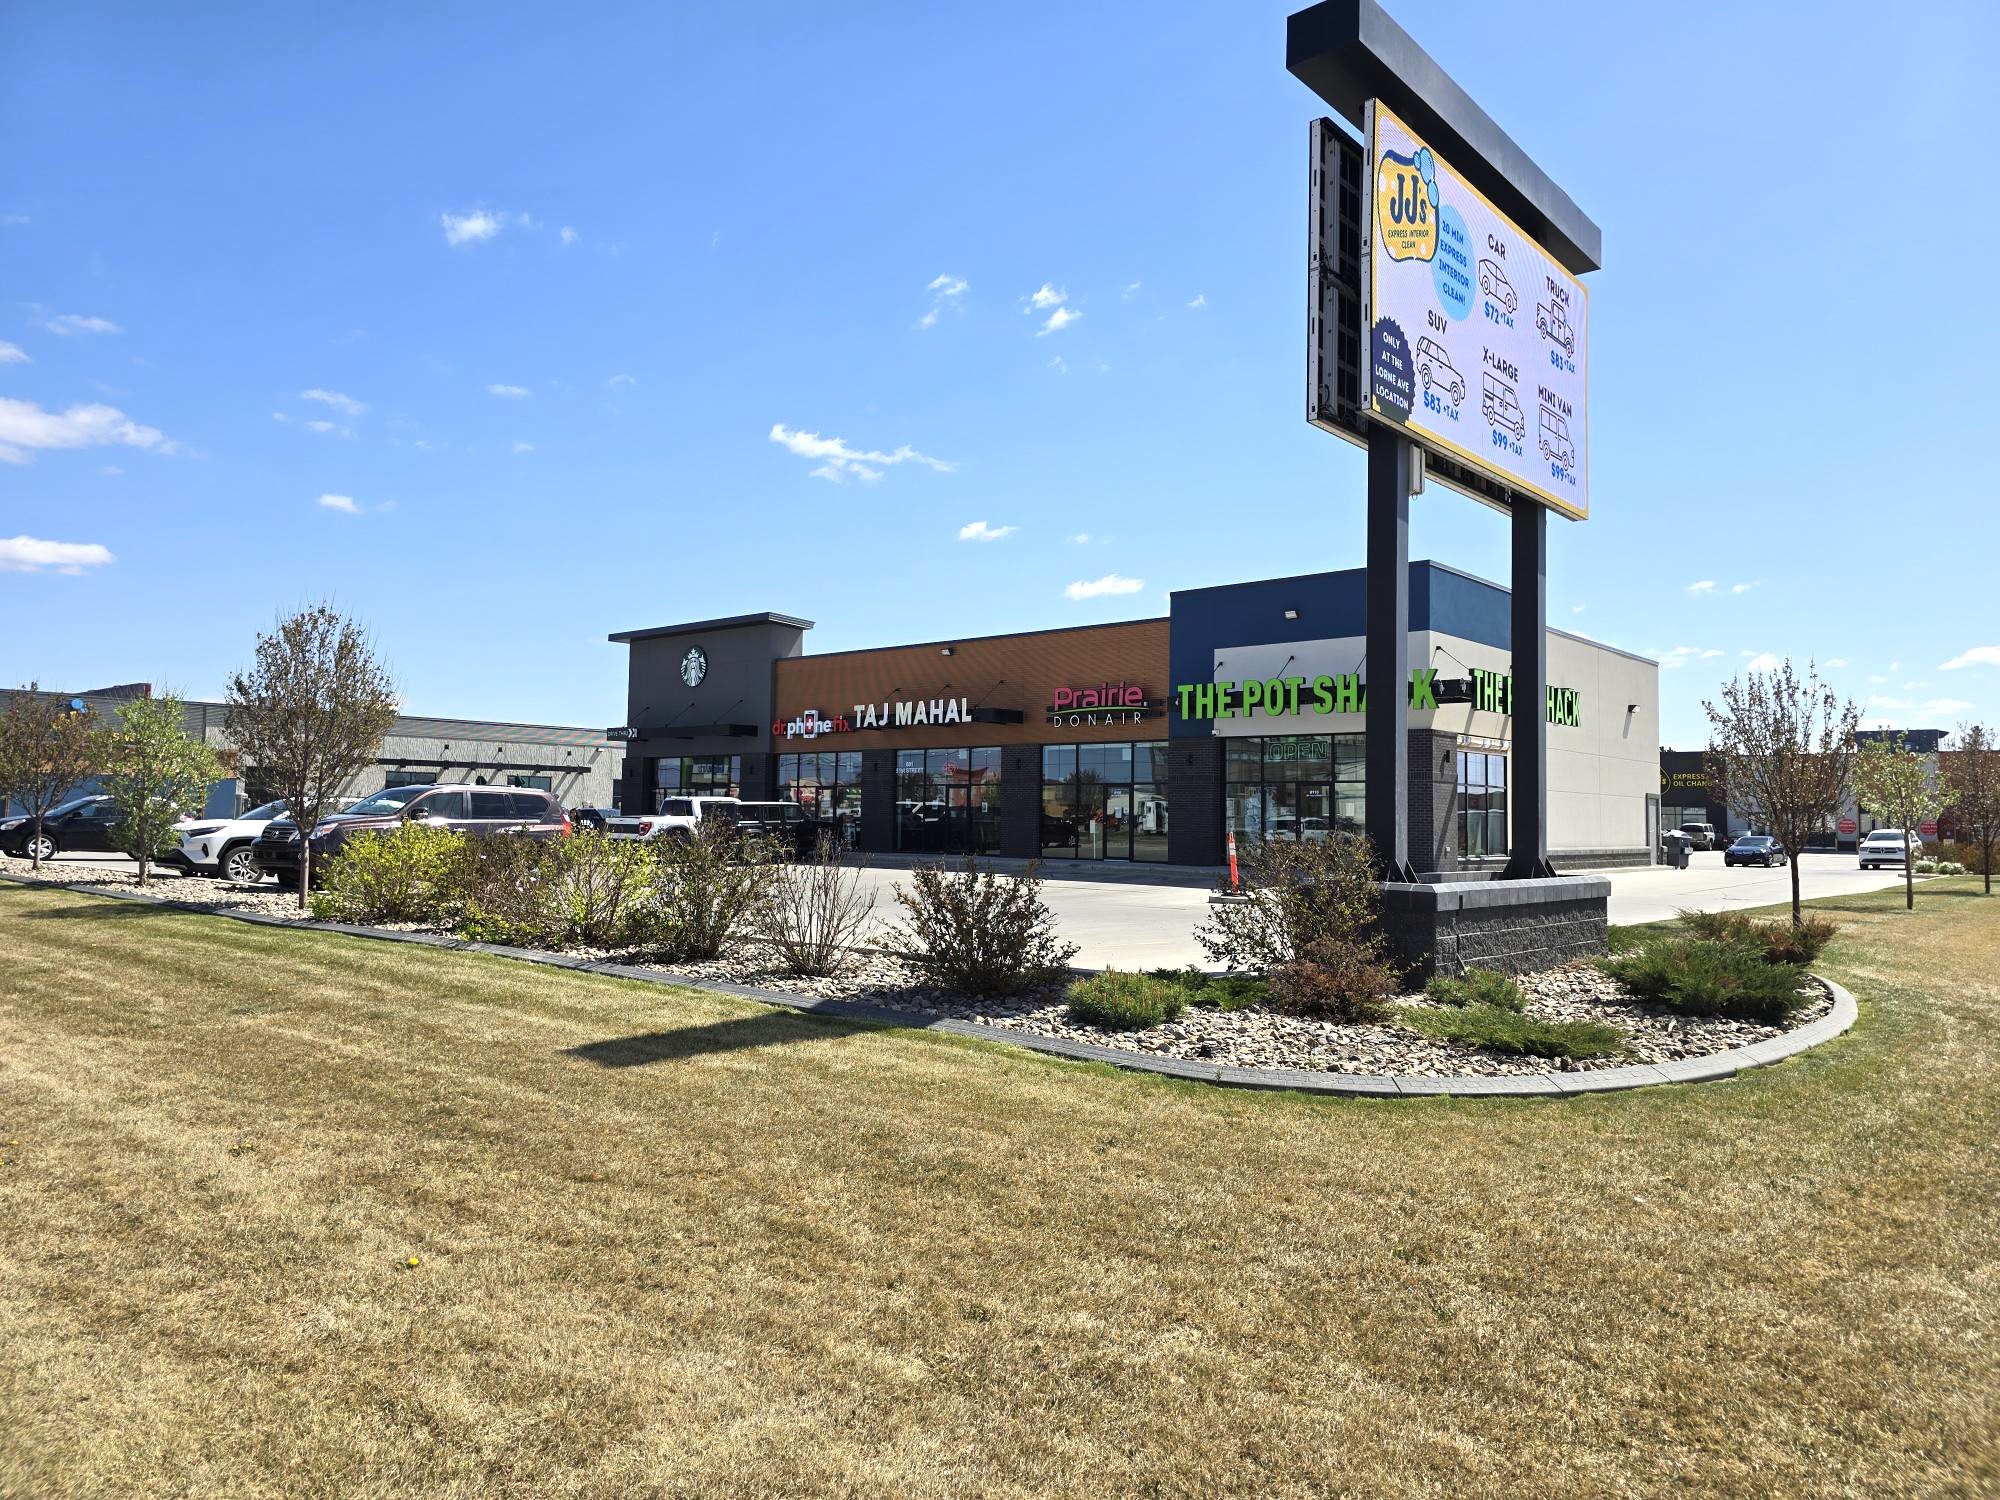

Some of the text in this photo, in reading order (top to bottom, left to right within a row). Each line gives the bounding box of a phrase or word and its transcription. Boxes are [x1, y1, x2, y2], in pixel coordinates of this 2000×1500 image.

[1390, 173, 1427, 225] JJ's
[1388, 228, 1430, 239] EXPRESS INTERIOR
[1401, 240, 1416, 250] CLEAN
[1451, 226, 1464, 246] MIN
[1440, 238, 1468, 268] EXPRESS
[1488, 233, 1506, 261] CAR
[1439, 258, 1470, 290] INTERIOR
[1442, 281, 1466, 306] CLEAN!
[1546, 275, 1570, 309] TRUCK
[1428, 309, 1448, 335] SUV
[1484, 300, 1500, 326] $72
[1383, 331, 1401, 350] ONLY
[1382, 350, 1404, 371] AT THE
[1483, 345, 1519, 384] X-LARGE
[1550, 349, 1564, 372] $83
[1375, 363, 1410, 394] LORNE AVE
[1375, 383, 1410, 411] LOCATION
[1423, 390, 1441, 415] $83
[1538, 383, 1572, 418] MINI VAN
[1492, 429, 1508, 451] $99
[1551, 461, 1564, 483] $99
[1177, 668, 1440, 720] THE POT SHK
[1472, 668, 1506, 716] THE
[853, 697, 973, 728] TAJ MAHAL
[1053, 711, 1143, 728] DONAIR
[1546, 685, 1581, 728] HACK
[1268, 742, 1328, 760] OPEN
